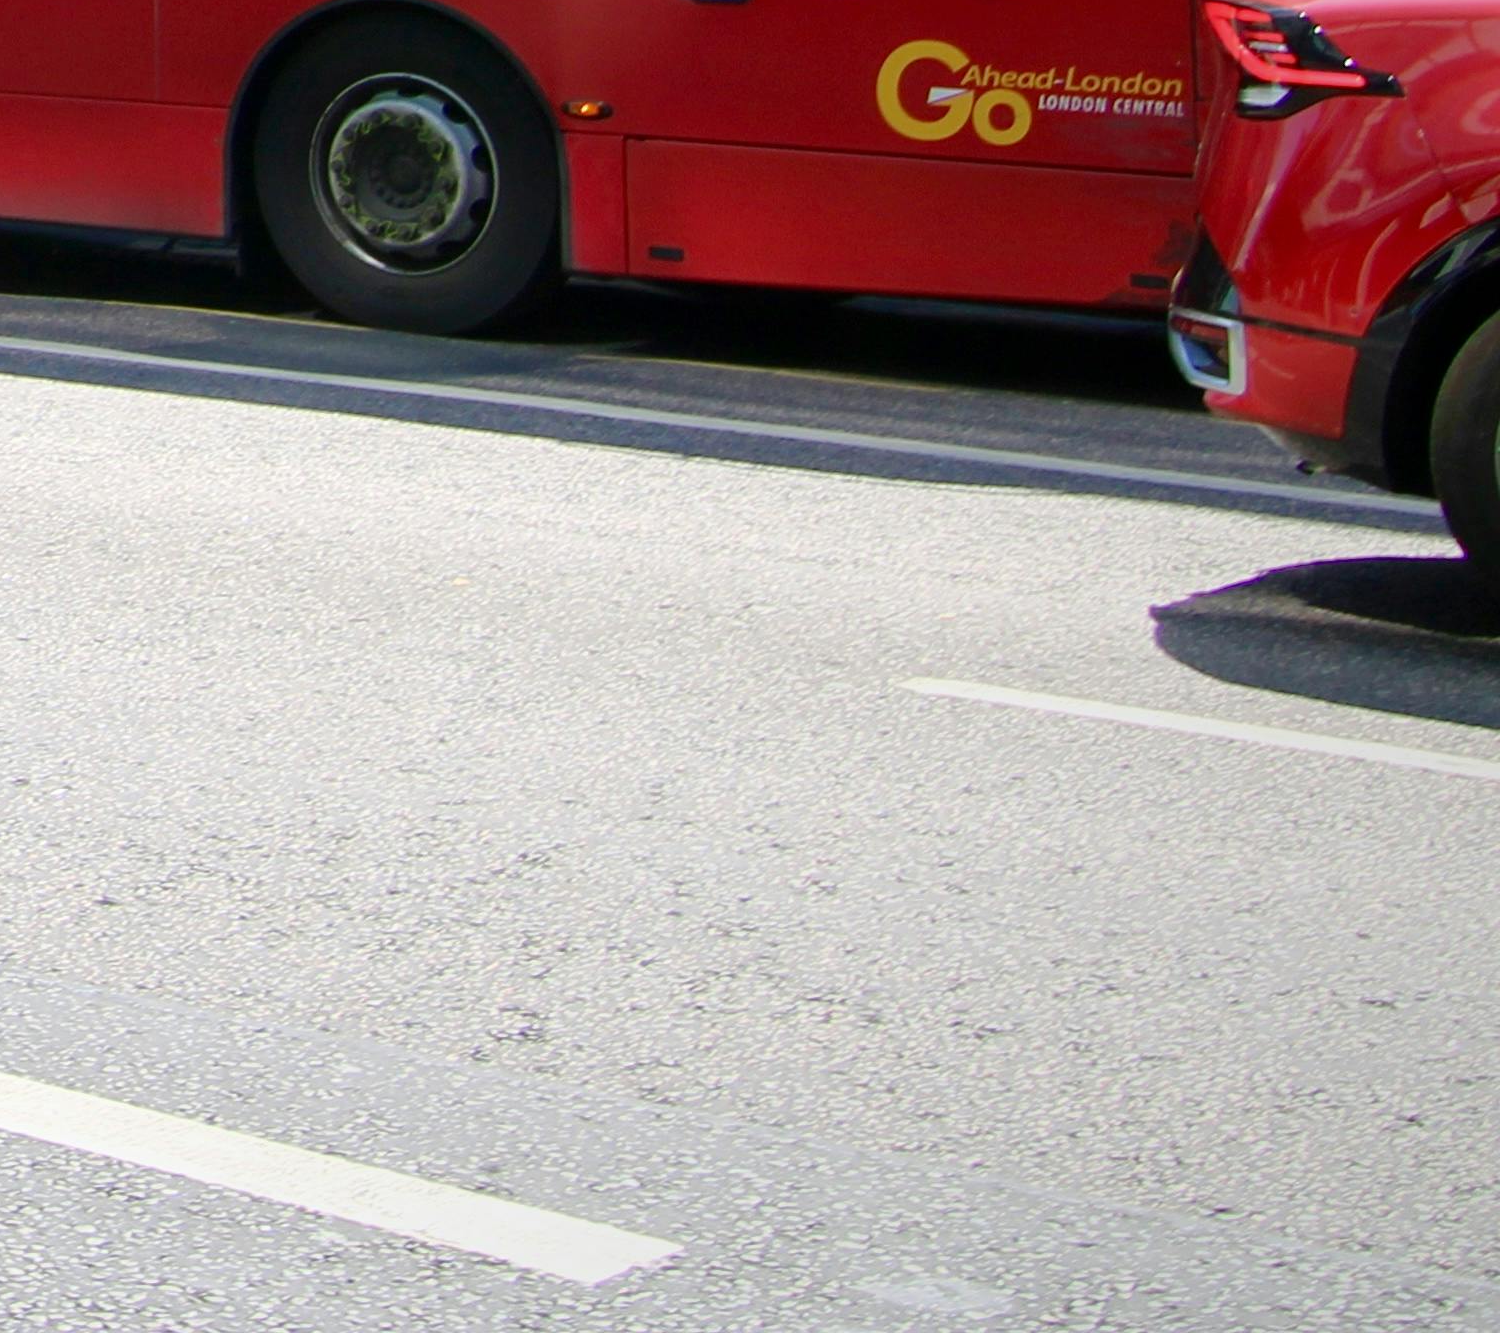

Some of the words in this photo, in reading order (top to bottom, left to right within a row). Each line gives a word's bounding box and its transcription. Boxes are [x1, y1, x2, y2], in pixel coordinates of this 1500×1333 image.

[875, 39, 1033, 147] Go
[960, 64, 1183, 96] Ahead-London
[1038, 94, 1106, 113] LONDON
[1112, 94, 1185, 117] CENTRAL
